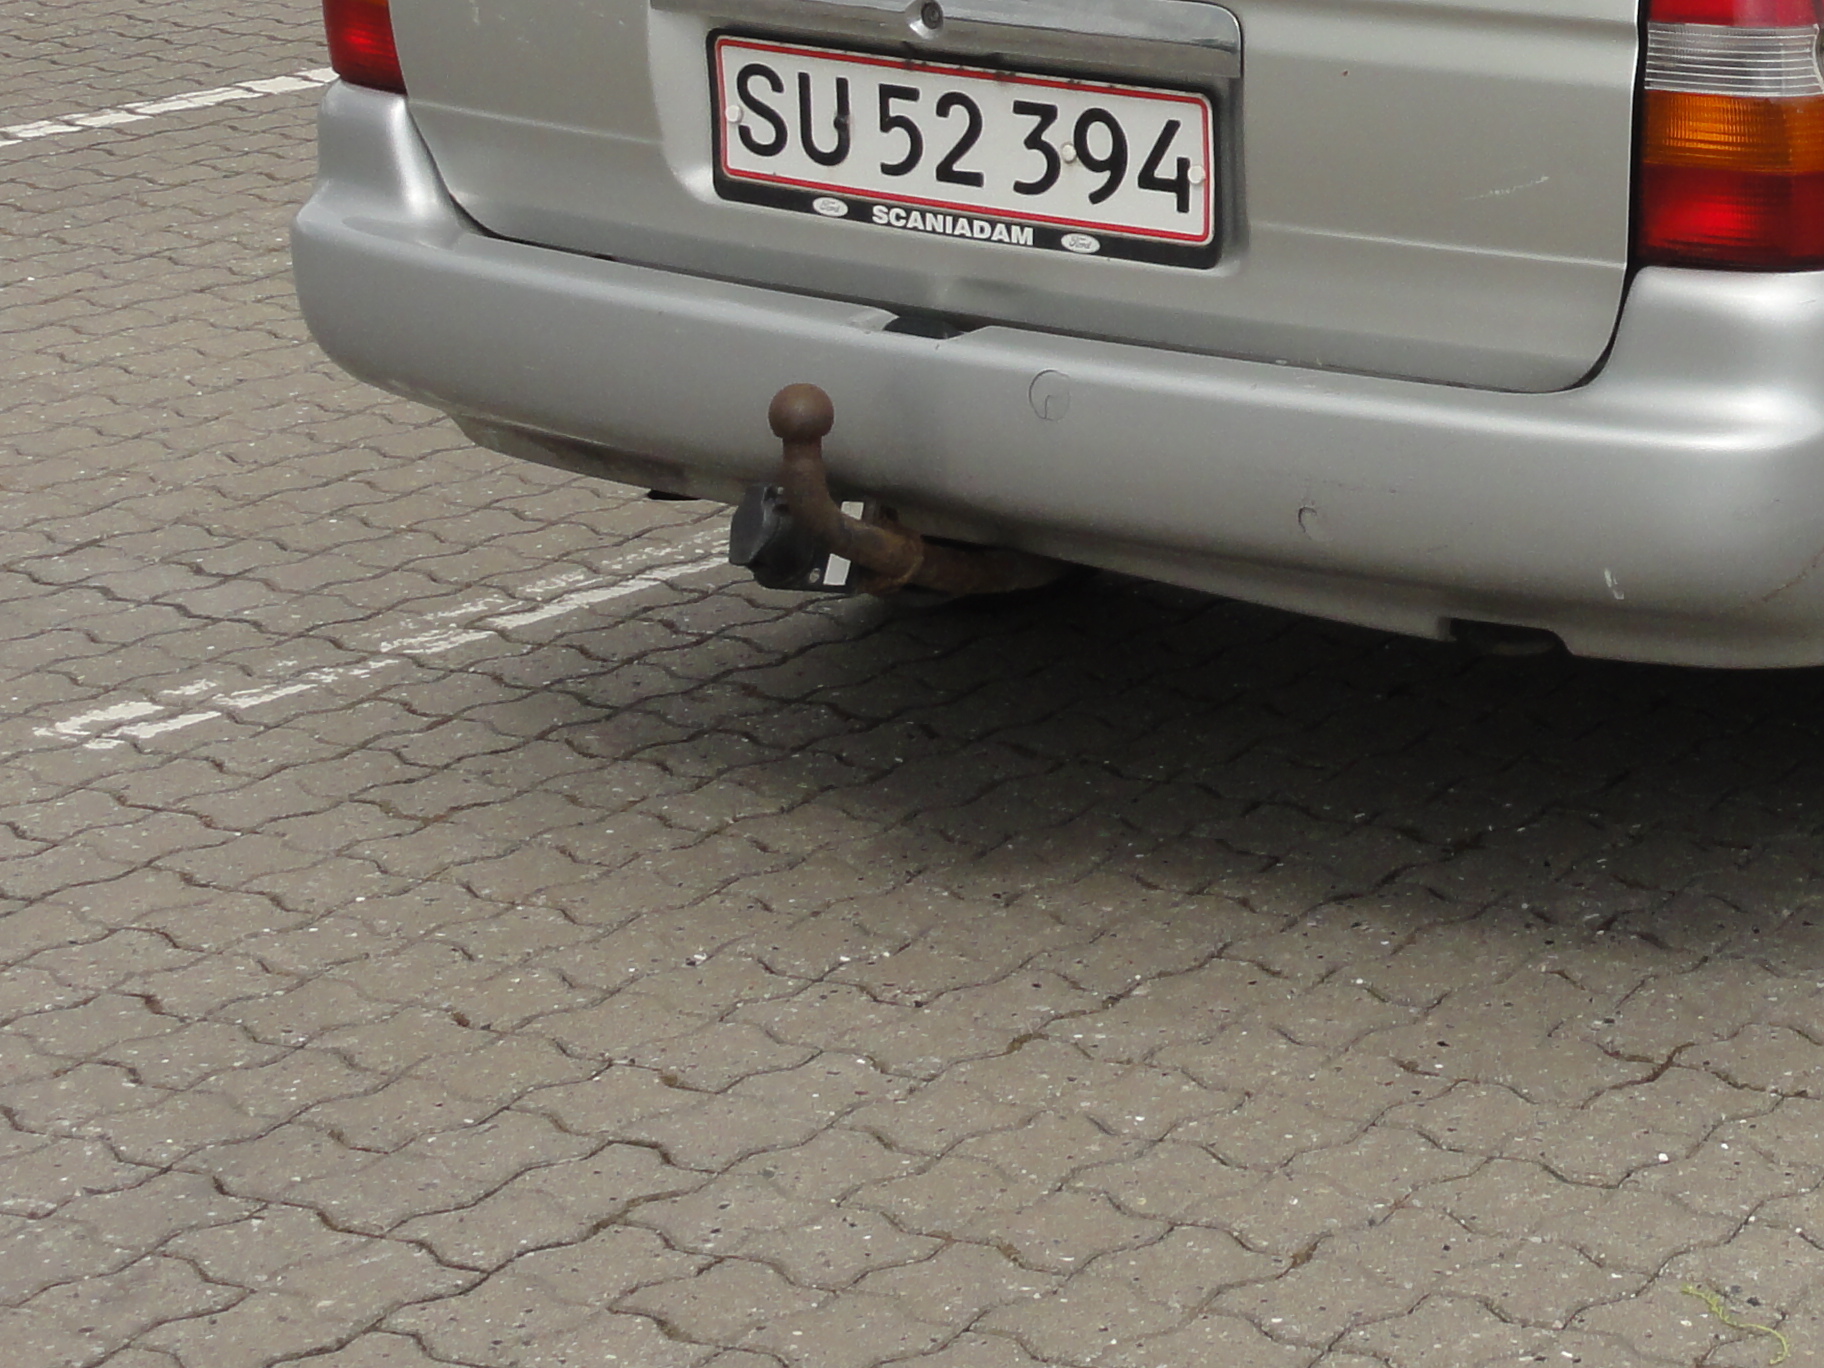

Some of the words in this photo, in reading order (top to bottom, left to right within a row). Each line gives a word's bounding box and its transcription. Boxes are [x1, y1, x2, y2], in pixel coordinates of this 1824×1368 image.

[735, 62, 852, 167] SU
[877, 82, 985, 188] 52
[1012, 99, 1193, 214] 394
[872, 204, 1034, 247] SCANIADAM
